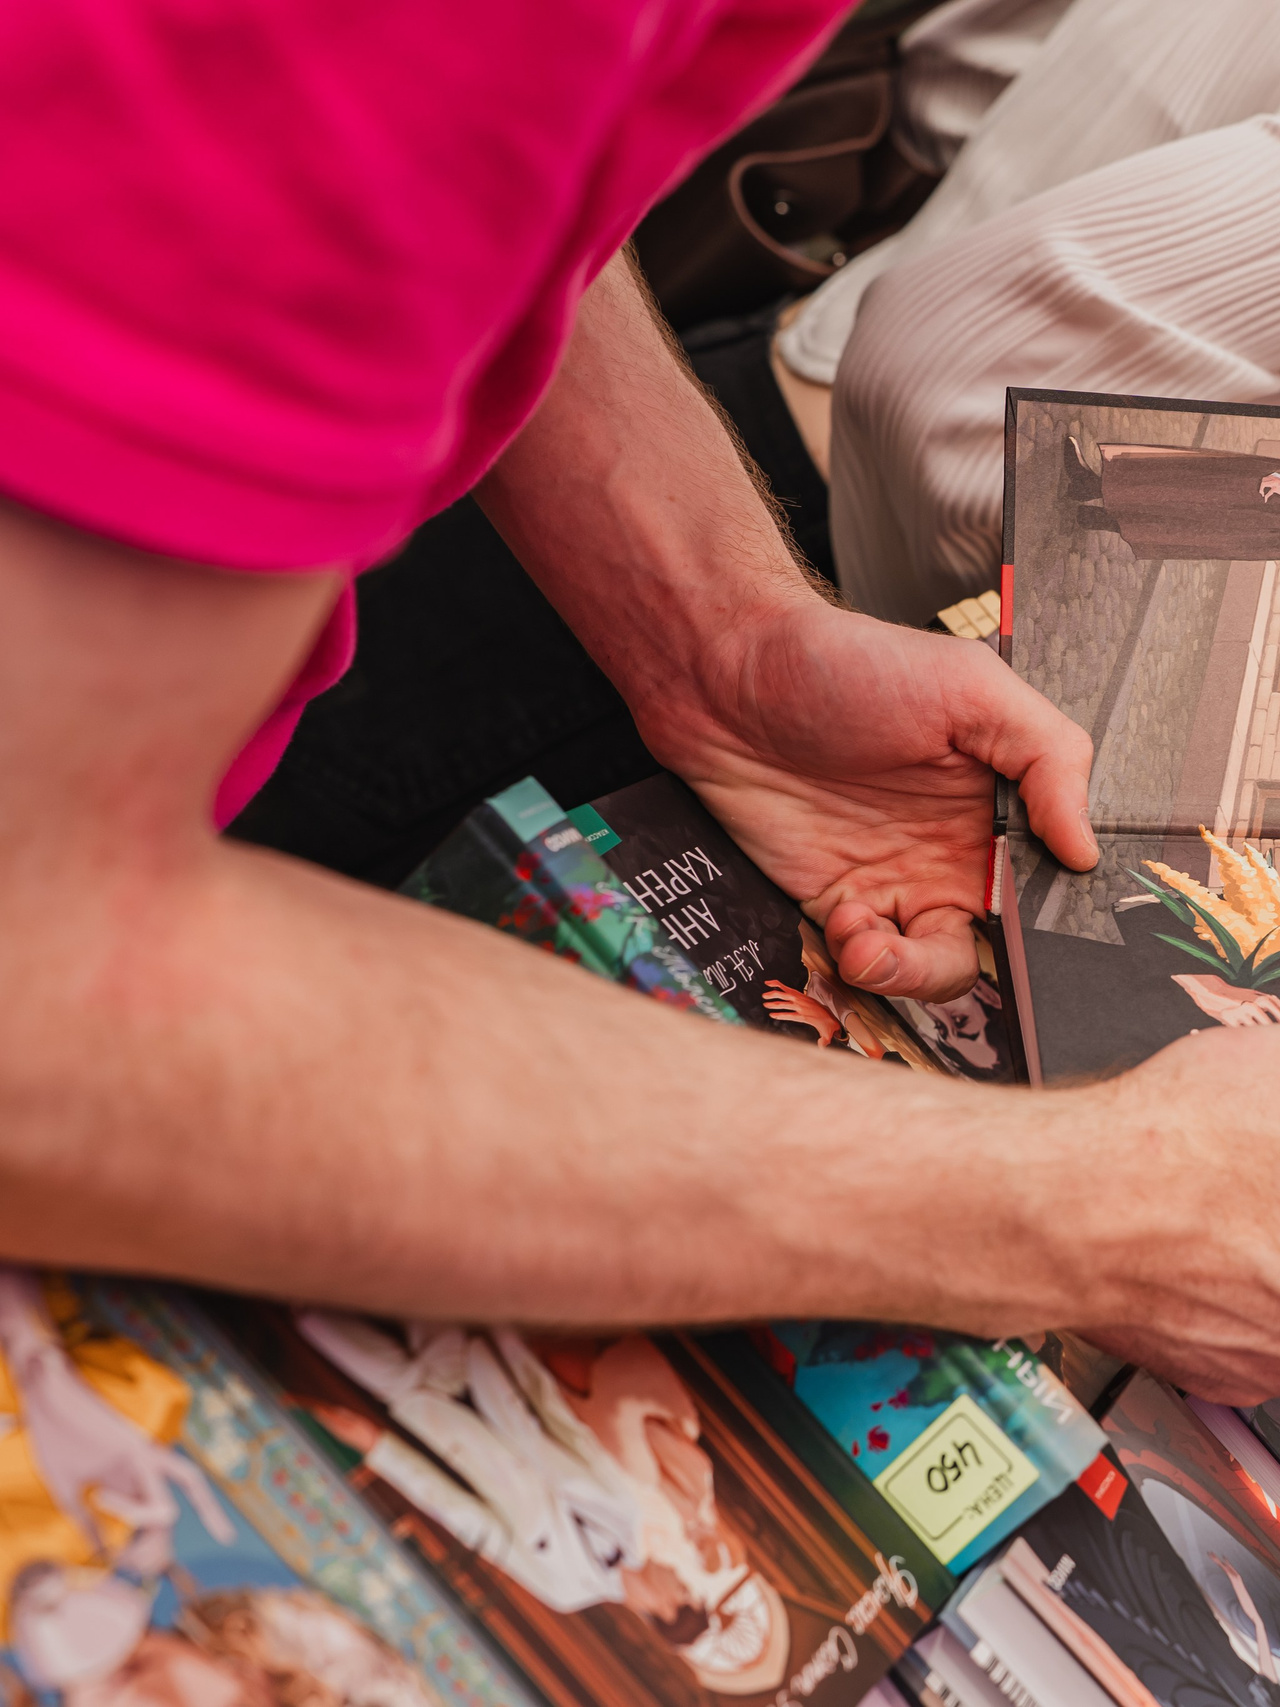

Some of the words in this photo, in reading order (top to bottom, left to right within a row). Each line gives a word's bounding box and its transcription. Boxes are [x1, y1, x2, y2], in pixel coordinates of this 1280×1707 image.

[584, 828, 610, 843] КЛАССИ
[623, 847, 722, 913] КАРЕН
[927, 1440, 982, 1493] 450
